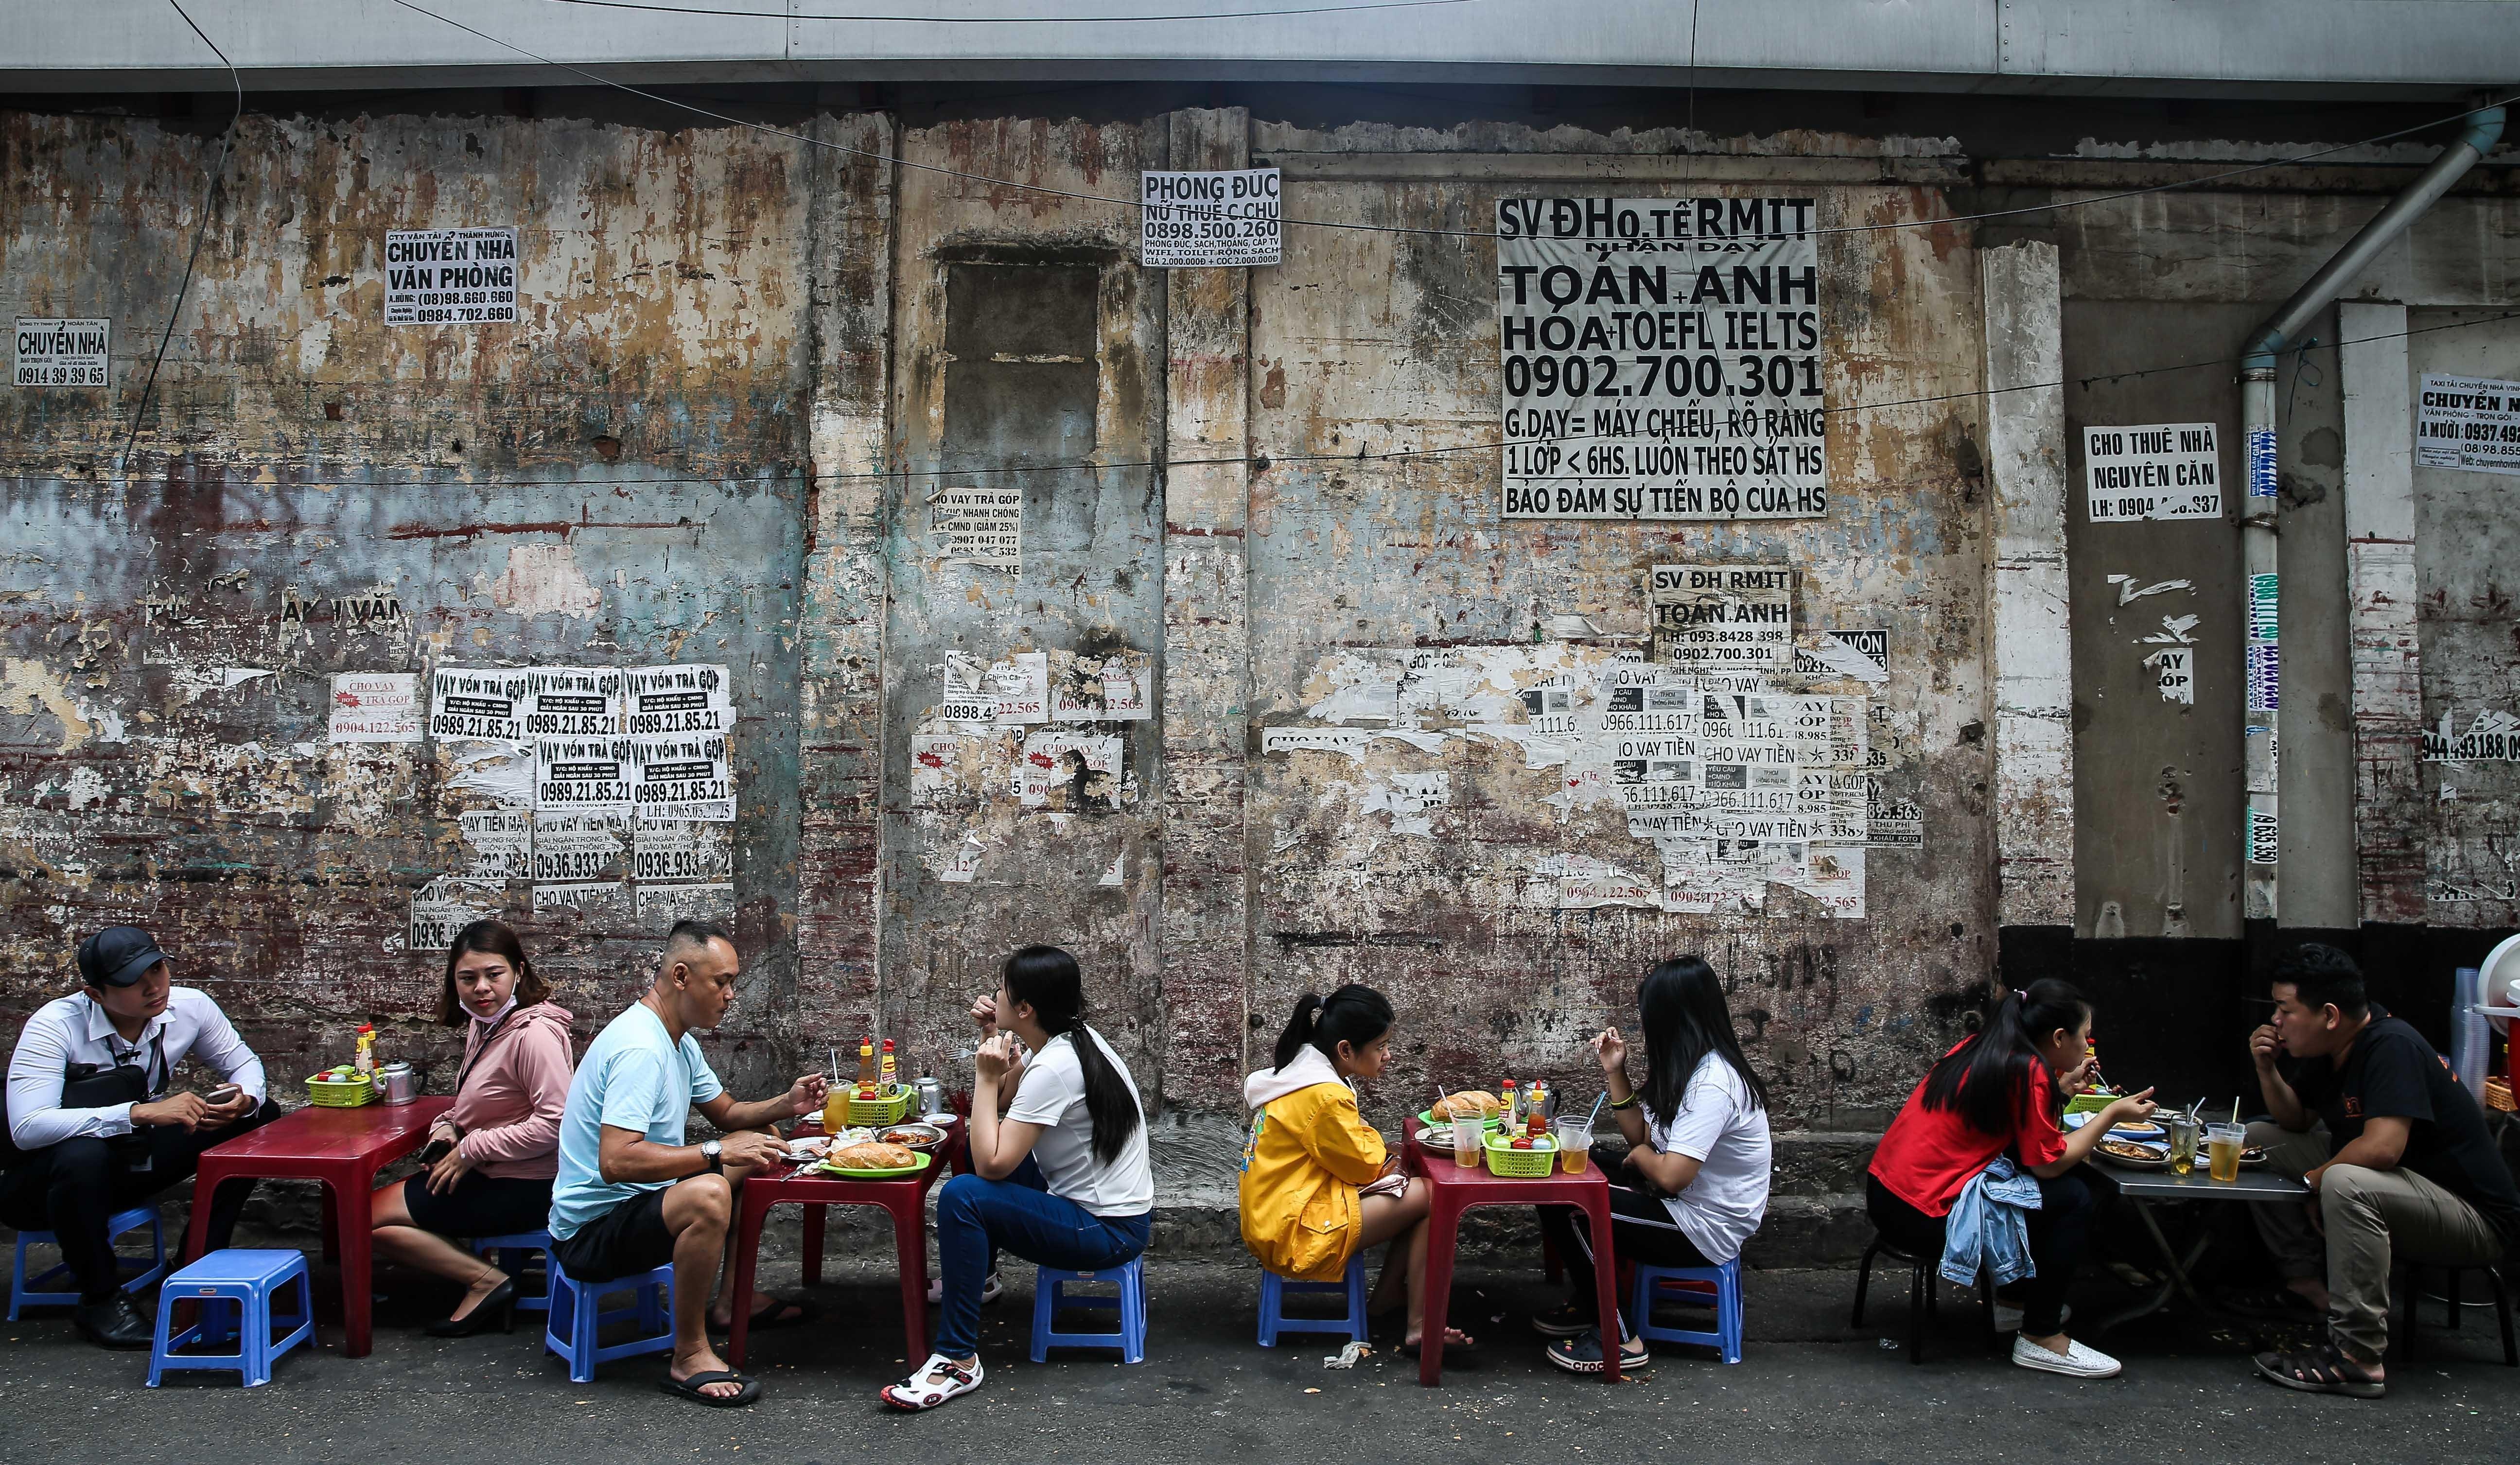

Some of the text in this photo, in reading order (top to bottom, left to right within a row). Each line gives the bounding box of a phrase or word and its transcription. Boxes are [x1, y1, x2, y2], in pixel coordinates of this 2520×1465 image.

[1145, 173, 1225, 200] PHÒNG
[1176, 199, 1222, 221] THUÊ
[1500, 198, 1543, 241] SV
[1698, 198, 1815, 241] RMIT
[407, 233, 425, 241] VẬN
[1145, 221, 1278, 239] 0898.500.260
[388, 231, 515, 262] CHUYỂN NHÀ
[1145, 238, 1172, 248] PHÒNG
[1251, 247, 1278, 255] SẠCH
[1697, 242, 1768, 255] DẠY
[1145, 254, 1278, 265] GIÁ 2.000.000Đ 2.000.000Đ
[389, 262, 512, 290] VĂN PHÒNG
[418, 291, 513, 306] (08)98.660.660
[418, 307, 513, 322] 0984.702.660
[18, 320, 106, 354] CHUYỂN NHÀ
[1725, 311, 1817, 351] IELTS
[19, 367, 104, 384] 0914 39 39 65
[1505, 354, 1823, 398] 0902.700.301
[2423, 390, 2501, 411] CHUYỂN
[1594, 397, 1825, 443] MÁY CHIẾU, RÕ RÀNG
[2419, 421, 2427, 436] A
[2090, 426, 2214, 455] CHO THUÊ NHÀ
[1508, 446, 1518, 475] 1
[1587, 446, 1630, 475] 6HS.
[1635, 436, 1688, 475] LUÔN
[1694, 446, 1748, 475] THEO
[1753, 435, 1790, 475] SÁT
[1796, 446, 1823, 475] HS
[2461, 454, 2475, 465] Web:
[2094, 460, 2214, 489] NGUYÊN CĂN
[951, 491, 1019, 504] VAY TRẢ GÓP
[1506, 479, 1826, 519] BẢO ĐẢM SỰ TIẾN BỘ CỦA HS
[963, 506, 1019, 518] NHANH CHÓNG
[2092, 499, 2113, 517] LH:
[948, 519, 1018, 532] CMND (GIẢM 25%)
[978, 536, 1017, 544] 047 077
[999, 547, 1017, 556] 532
[1655, 572, 1788, 589] SV ĐH RMIT
[1690, 631, 1753, 642] 093.8428
[1673, 647, 1772, 659] 0902.700.301
[436, 673, 525, 704] VAY VỐN TRẢ GÓP
[528, 671, 619, 699] VAY VỐN TRẢ GÓP
[627, 666, 719, 699] VAY VỐN TRẢ GÓP
[1735, 678, 1760, 692] VAY
[388, 693, 409, 703] GÓP
[336, 722, 416, 733] 0904.122.565
[433, 715, 520, 740] 0989.21.85.21
[527, 714, 615, 734] 0989.21.85.21
[630, 711, 720, 734] 0989.21.85.21
[1637, 736, 1695, 756] VAY TIỀN
[1737, 744, 1794, 763] VAY TIỀN
[1843, 770, 1865, 789] GÓP
[541, 782, 630, 802] 0989.21.85.21
[635, 780, 726, 803] 0989.21.85.21
[647, 805, 665, 817] LH:
[483, 812, 505, 832] TIỀN
[1750, 817, 1806, 837] VAY TIỀN
[534, 889, 557, 905] CHO
[1573, 1361, 1604, 1371] croc
